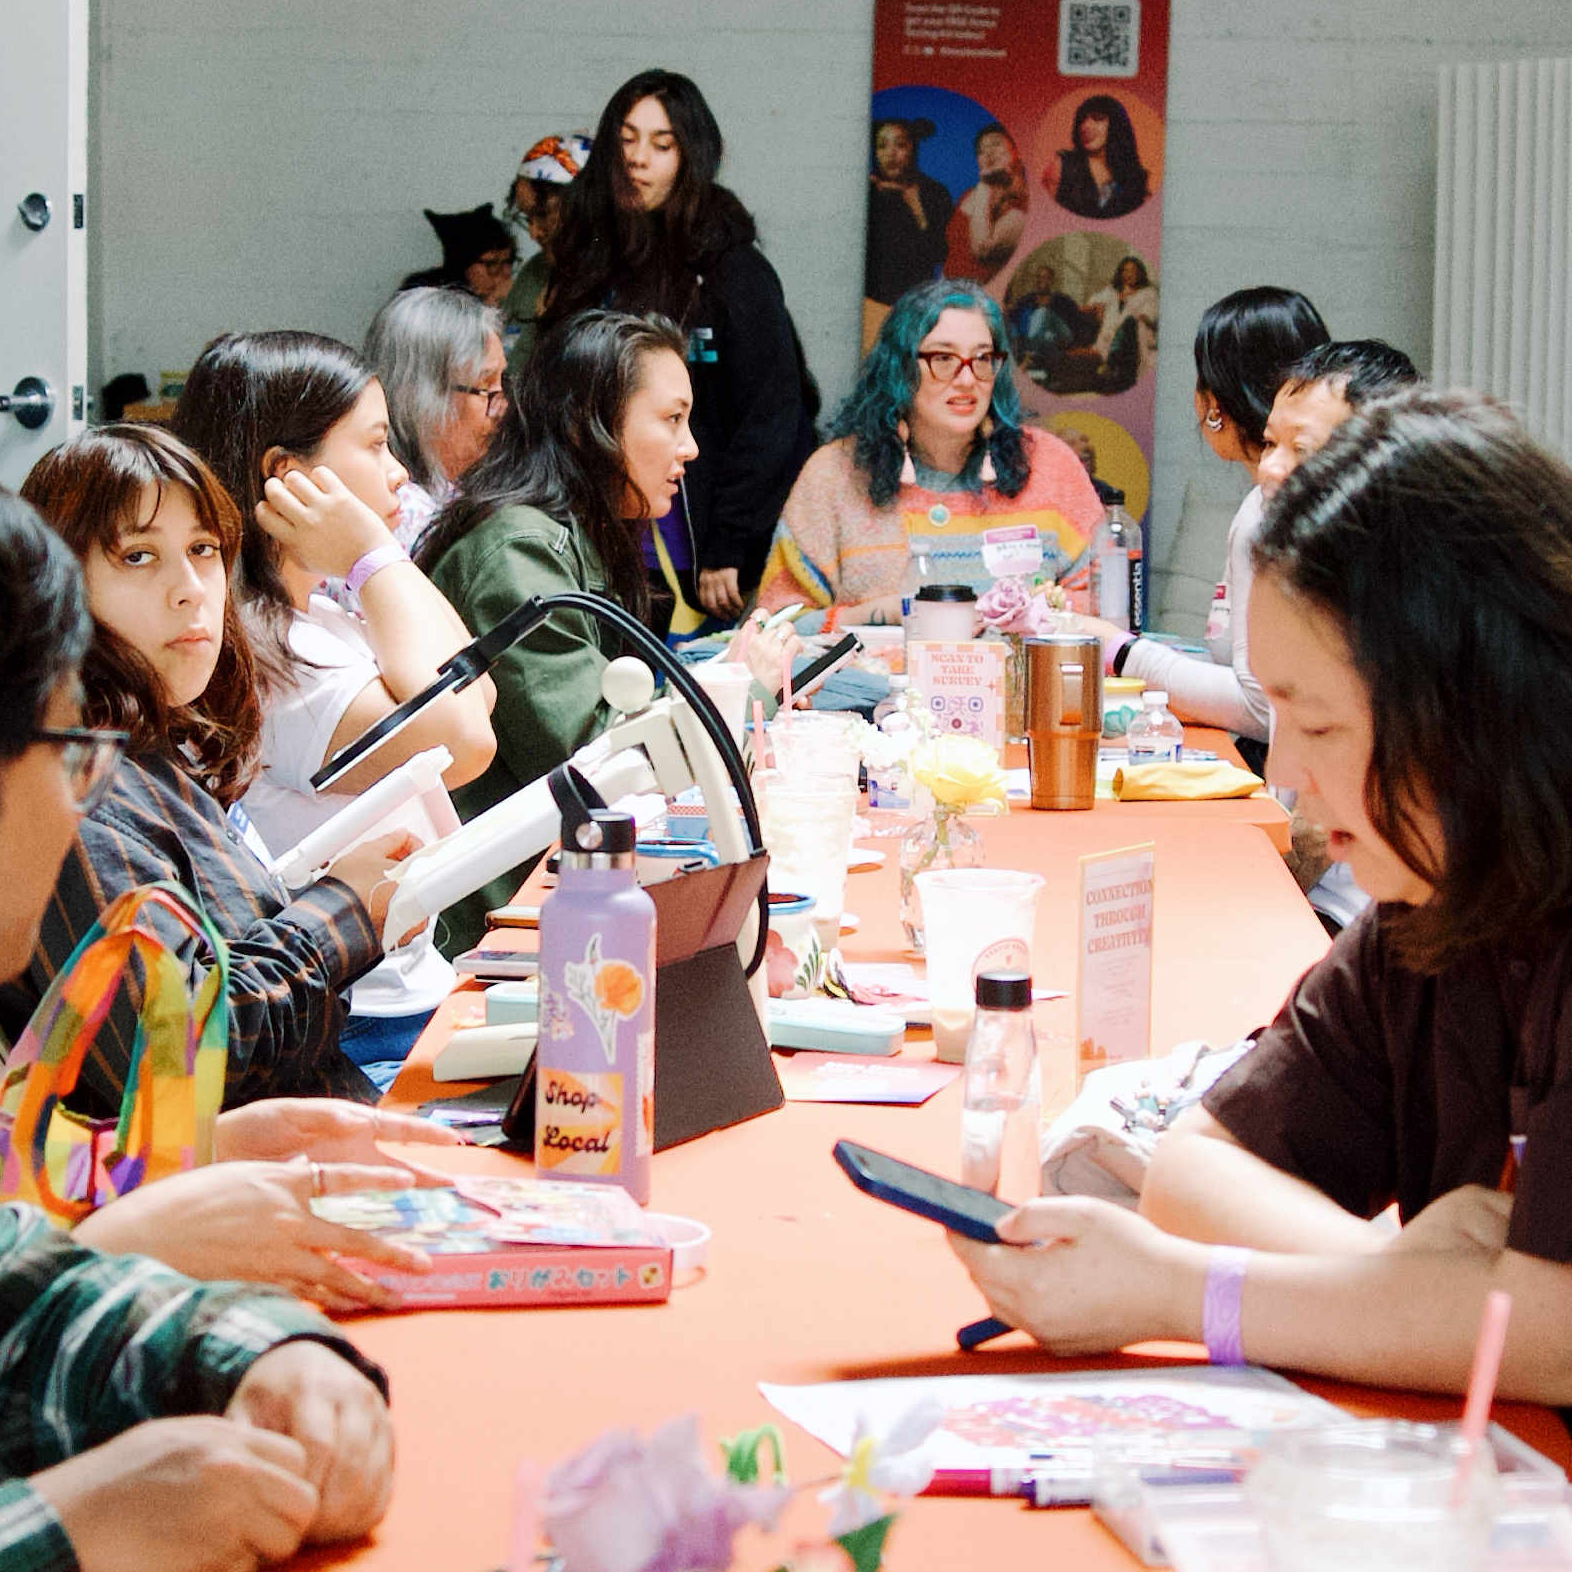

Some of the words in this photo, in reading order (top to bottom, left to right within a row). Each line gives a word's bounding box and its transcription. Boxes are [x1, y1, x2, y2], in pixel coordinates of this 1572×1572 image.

[1133, 562, 1143, 627] essentia
[931, 654, 963, 663] SCAN
[966, 655, 983, 664] TO
[941, 665, 974, 674] TAKE
[933, 675, 982, 686] SURVEY
[1086, 879, 1153, 905] CONNECTION
[1094, 904, 1146, 928] THROUGH
[545, 1080, 598, 1114] Shop
[543, 1125, 610, 1153] Local
